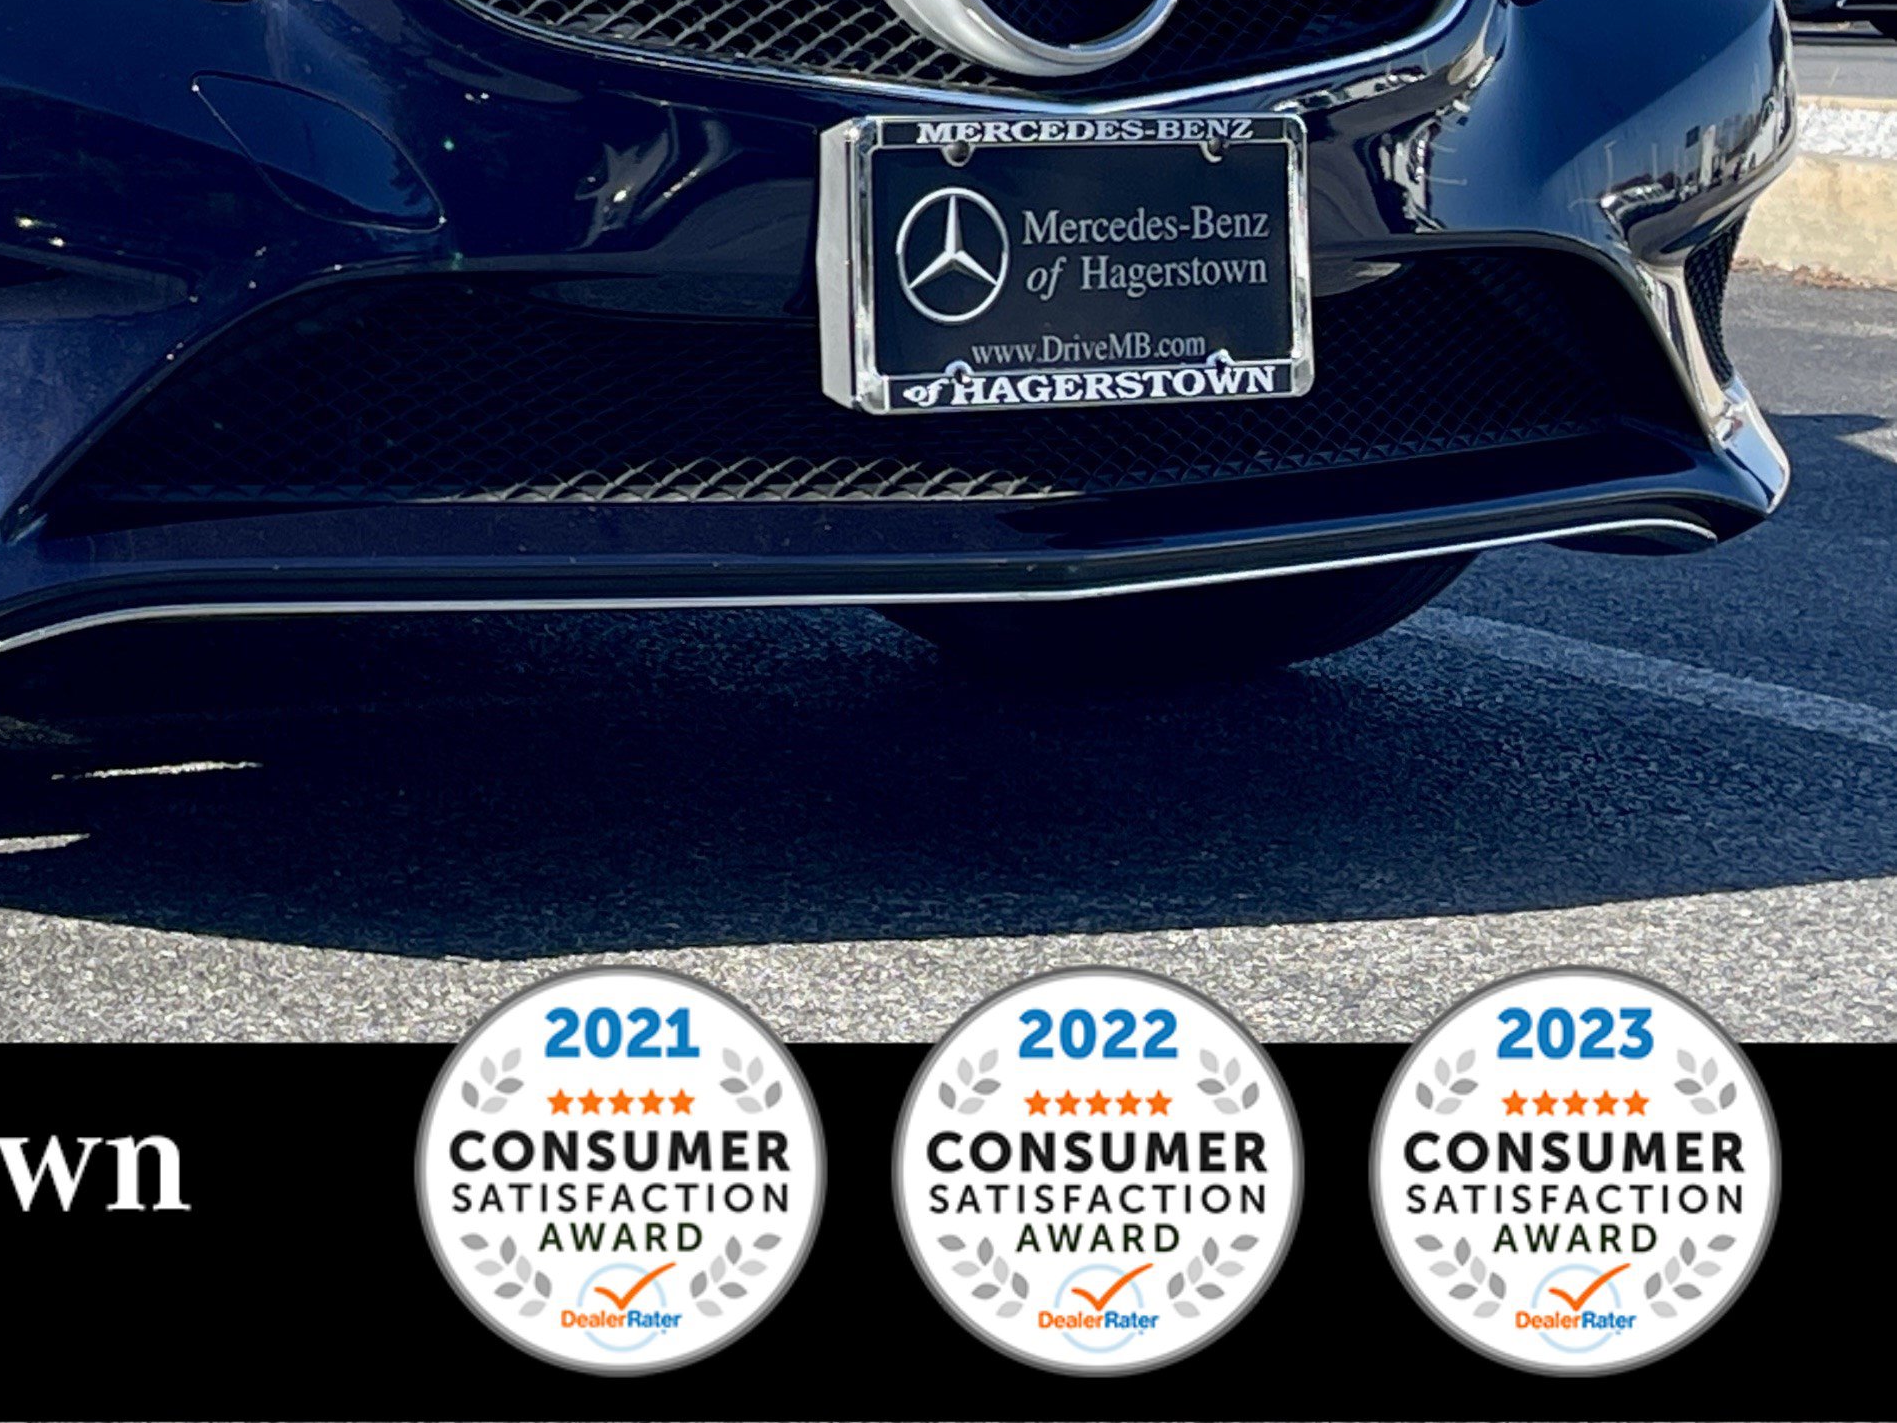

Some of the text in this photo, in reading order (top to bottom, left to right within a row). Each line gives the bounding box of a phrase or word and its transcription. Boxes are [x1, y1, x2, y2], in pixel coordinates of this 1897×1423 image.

[915, 118, 1254, 145] MERCEDES-BENZ
[1021, 205, 1270, 246] Mercedes-Benz
[1025, 254, 1269, 301] of Hagerstown
[970, 332, 1207, 365] www.DriveMB.com
[902, 365, 1276, 407] of HAGERSTOWN
